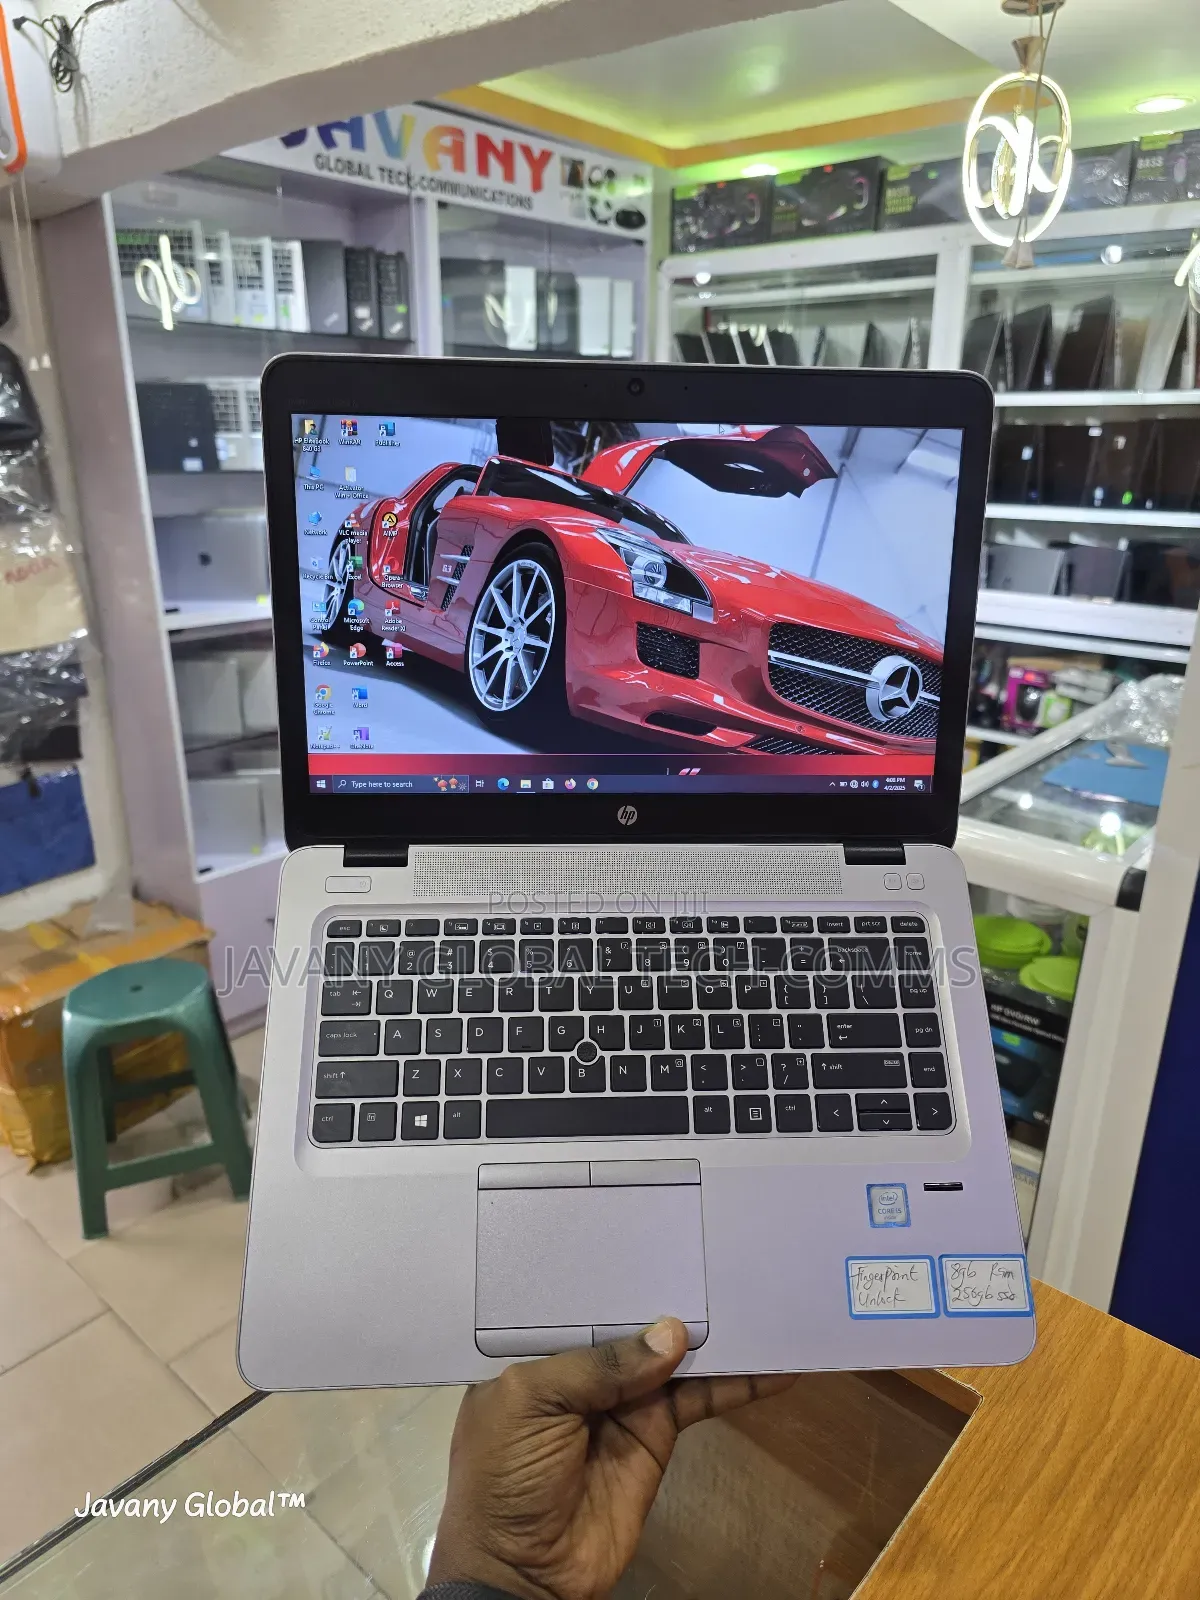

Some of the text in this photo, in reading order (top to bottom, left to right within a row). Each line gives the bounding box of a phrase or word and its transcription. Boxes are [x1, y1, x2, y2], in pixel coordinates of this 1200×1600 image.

[314, 153, 375, 180] GLOBAL
[351, 780, 367, 788] Type
[617, 805, 638, 826] hp
[406, 950, 415, 958] @
[446, 948, 453, 956] #
[406, 962, 413, 970] 2
[447, 961, 453, 969] 3
[487, 961, 494, 969] 4
[526, 960, 533, 968] 5
[566, 960, 573, 968] 6
[605, 959, 612, 967] 7
[644, 959, 651, 967] 8
[683, 959, 690, 967] 9
[384, 989, 394, 999] Q
[426, 988, 438, 997] W
[465, 988, 473, 997] E
[506, 988, 513, 996] R
[545, 986, 553, 995] T
[587, 986, 594, 995] Y
[624, 985, 633, 994] U
[705, 985, 714, 994] O
[744, 985, 752, 994] P
[393, 1029, 402, 1039] A
[435, 1029, 442, 1038] S
[475, 1028, 484, 1037] D
[516, 1027, 523, 1036] F
[557, 1026, 566, 1035] G
[597, 1025, 605, 1034] H
[636, 1025, 643, 1034] J
[677, 1025, 686, 1034] K
[717, 1025, 724, 1034] L
[412, 1069, 420, 1079] Z
[454, 1068, 462, 1078] X
[495, 1067, 504, 1077] C
[537, 1066, 546, 1076] V
[578, 1069, 586, 1078] B
[619, 1065, 627, 1075] N
[660, 1065, 670, 1074] M
